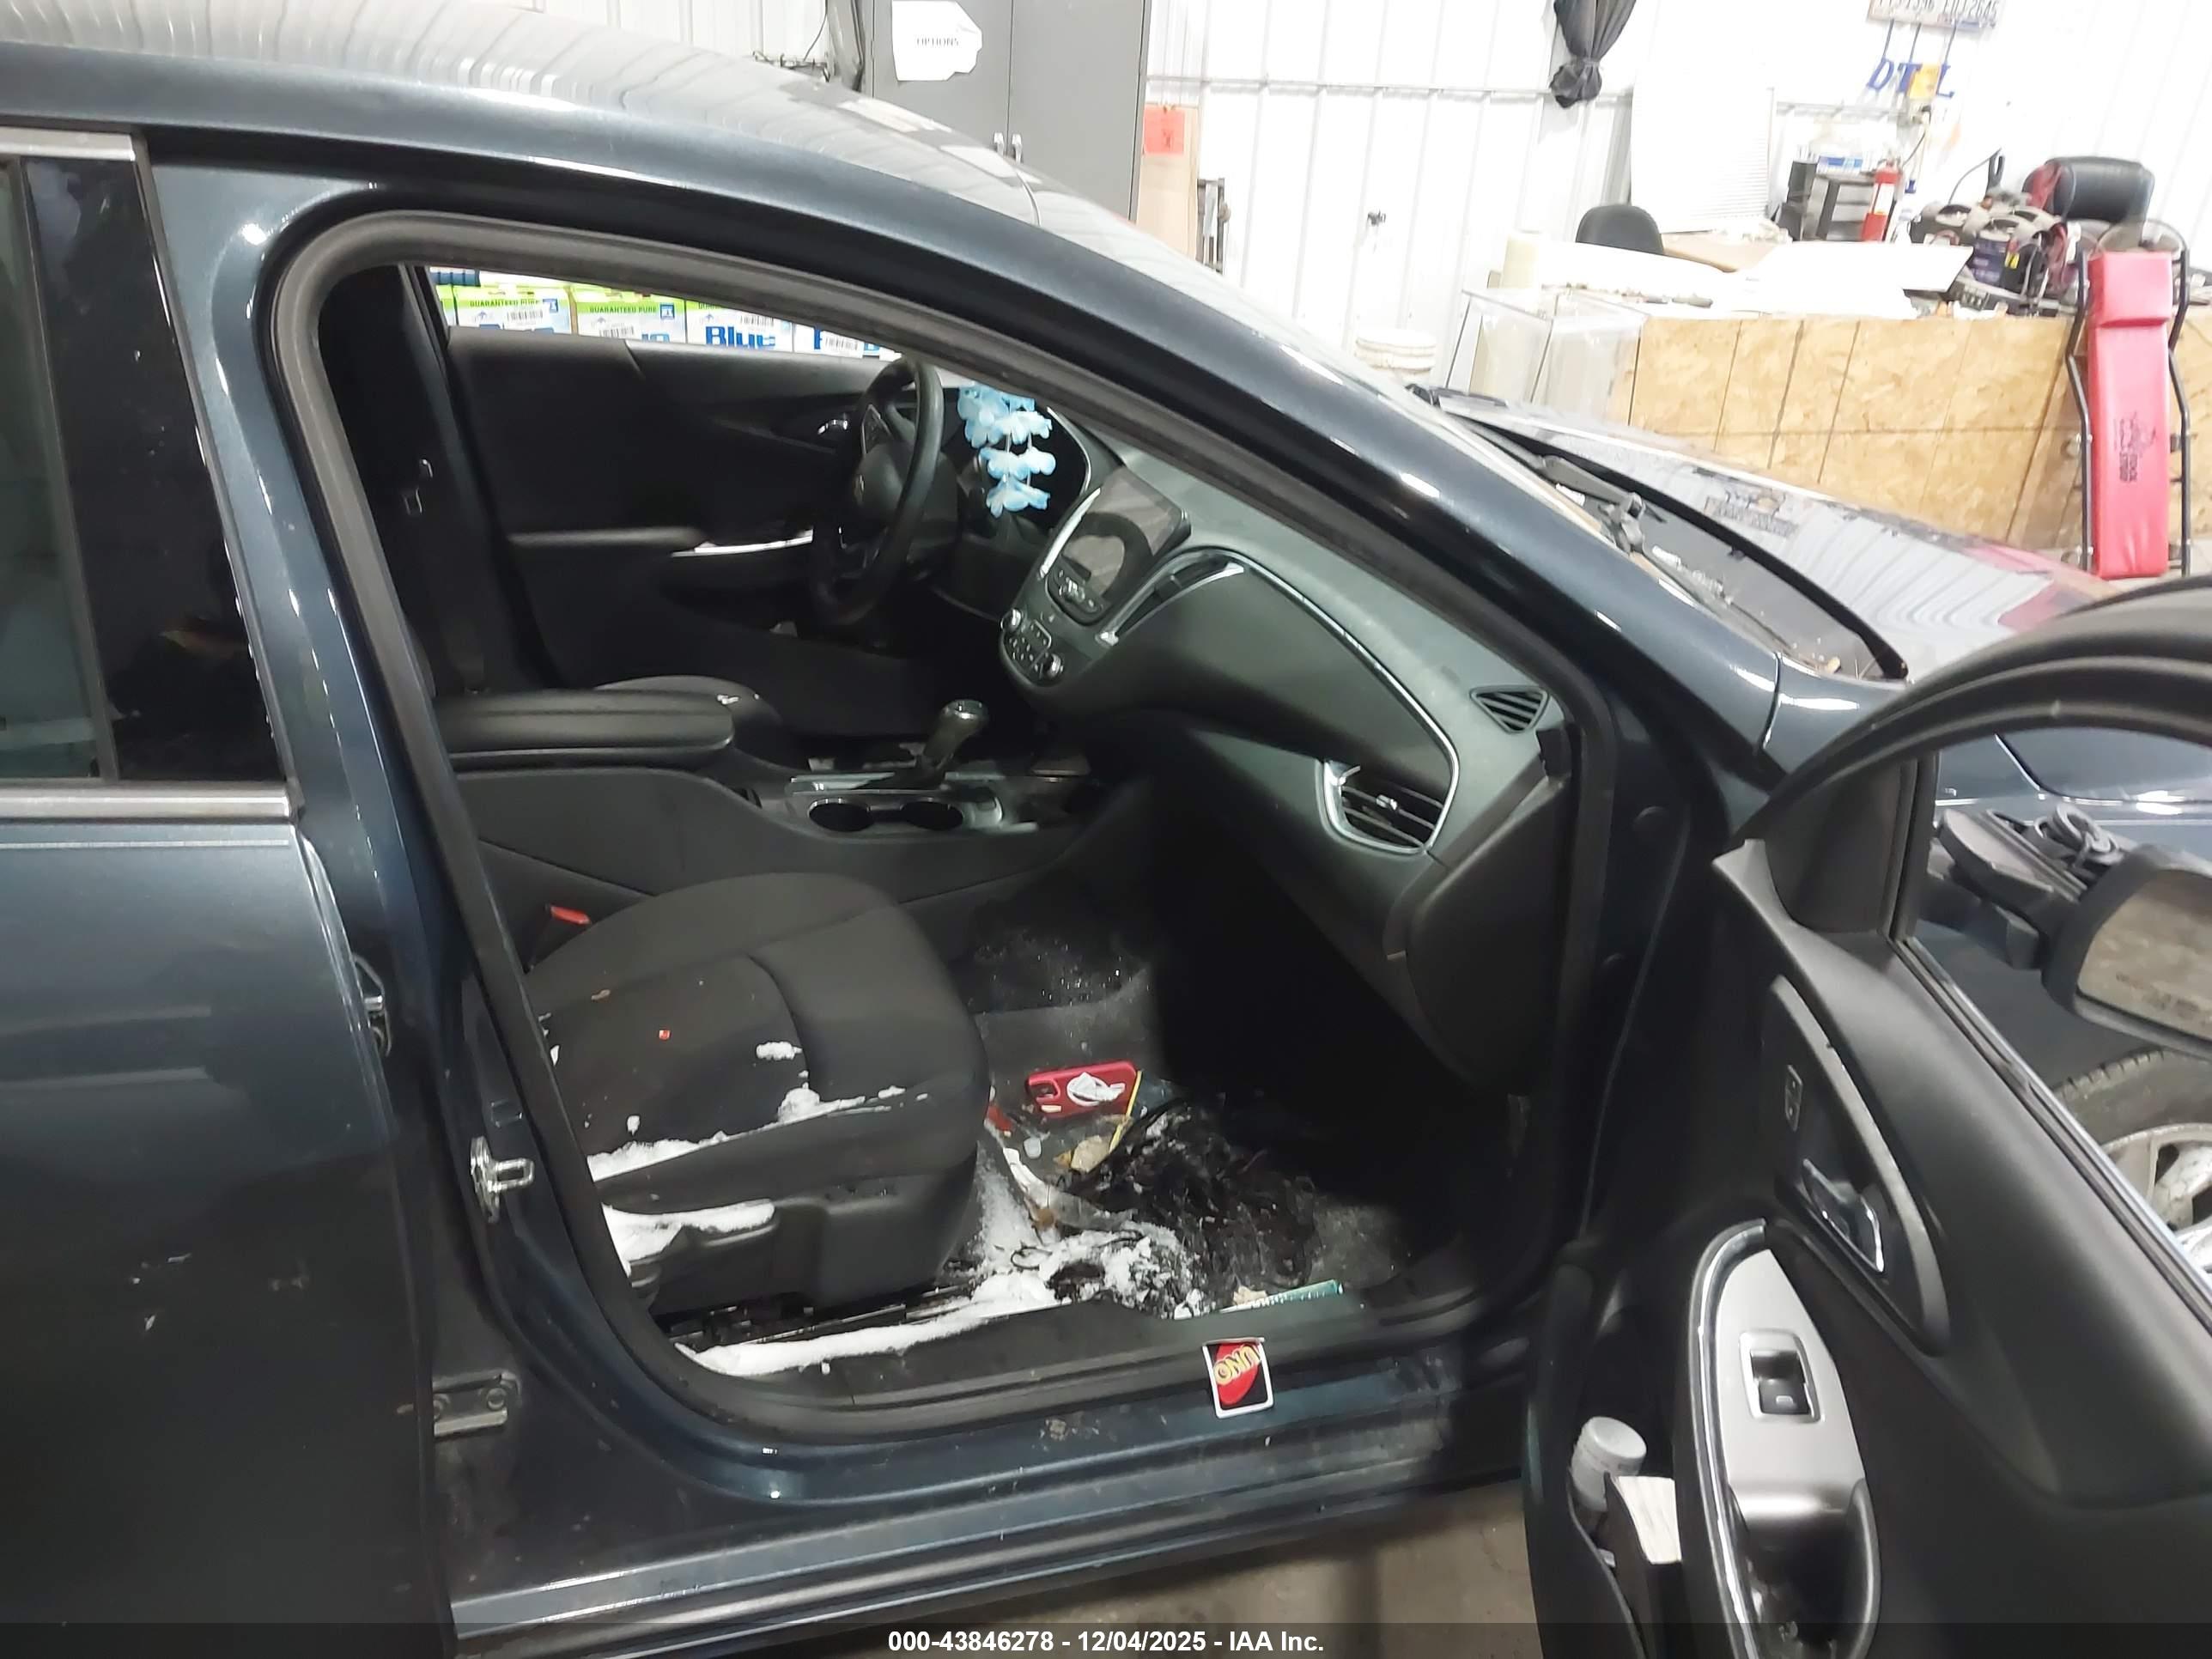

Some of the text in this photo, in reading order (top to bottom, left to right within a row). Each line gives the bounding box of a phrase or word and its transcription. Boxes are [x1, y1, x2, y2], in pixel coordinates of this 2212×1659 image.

[470, 299, 519, 307] GUARANTEED
[589, 305, 636, 313] GUARANTEED
[1212, 1344, 1261, 1385] UNO
